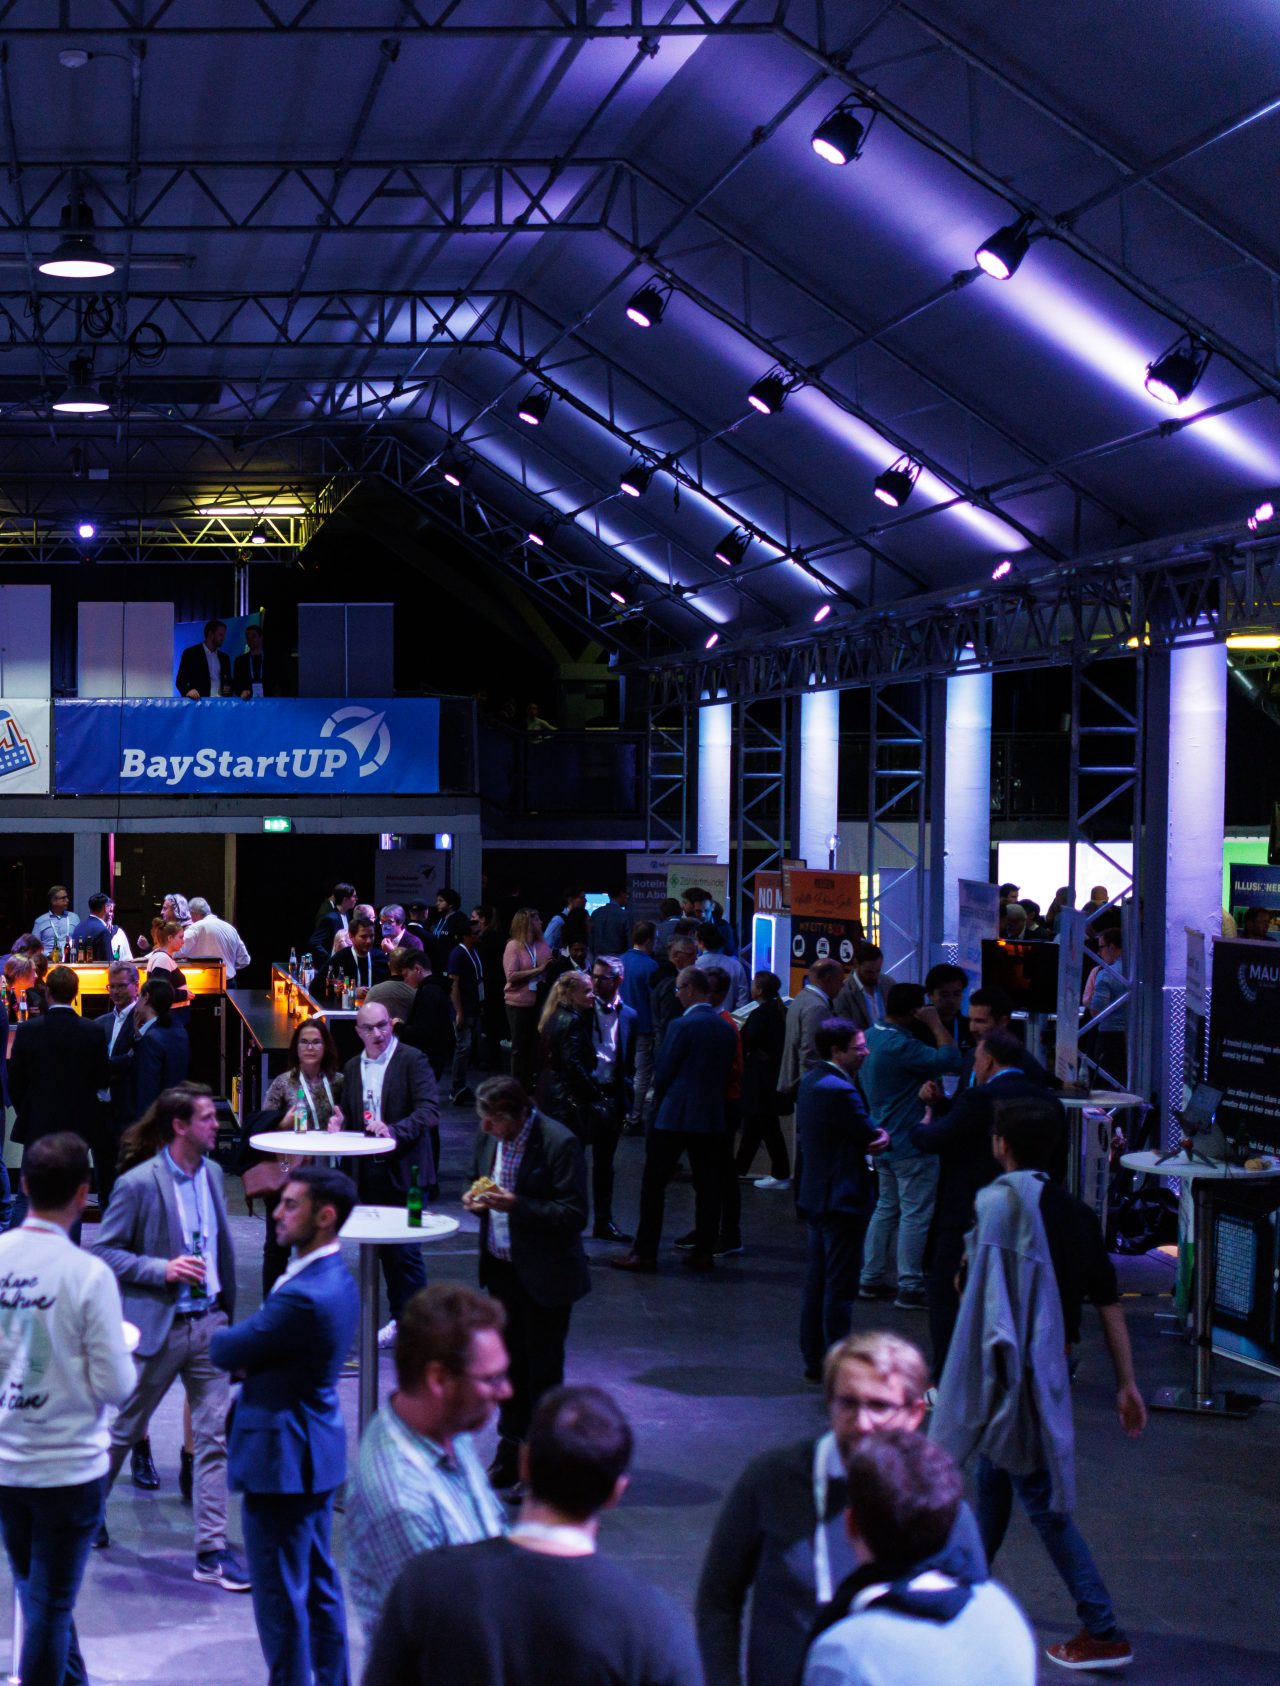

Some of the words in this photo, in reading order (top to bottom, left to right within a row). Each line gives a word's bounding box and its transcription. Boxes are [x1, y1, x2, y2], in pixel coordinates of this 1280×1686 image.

[120, 748, 348, 785] BayStartUP
[645, 891, 667, 899] Abo
[758, 887, 773, 909] NO
